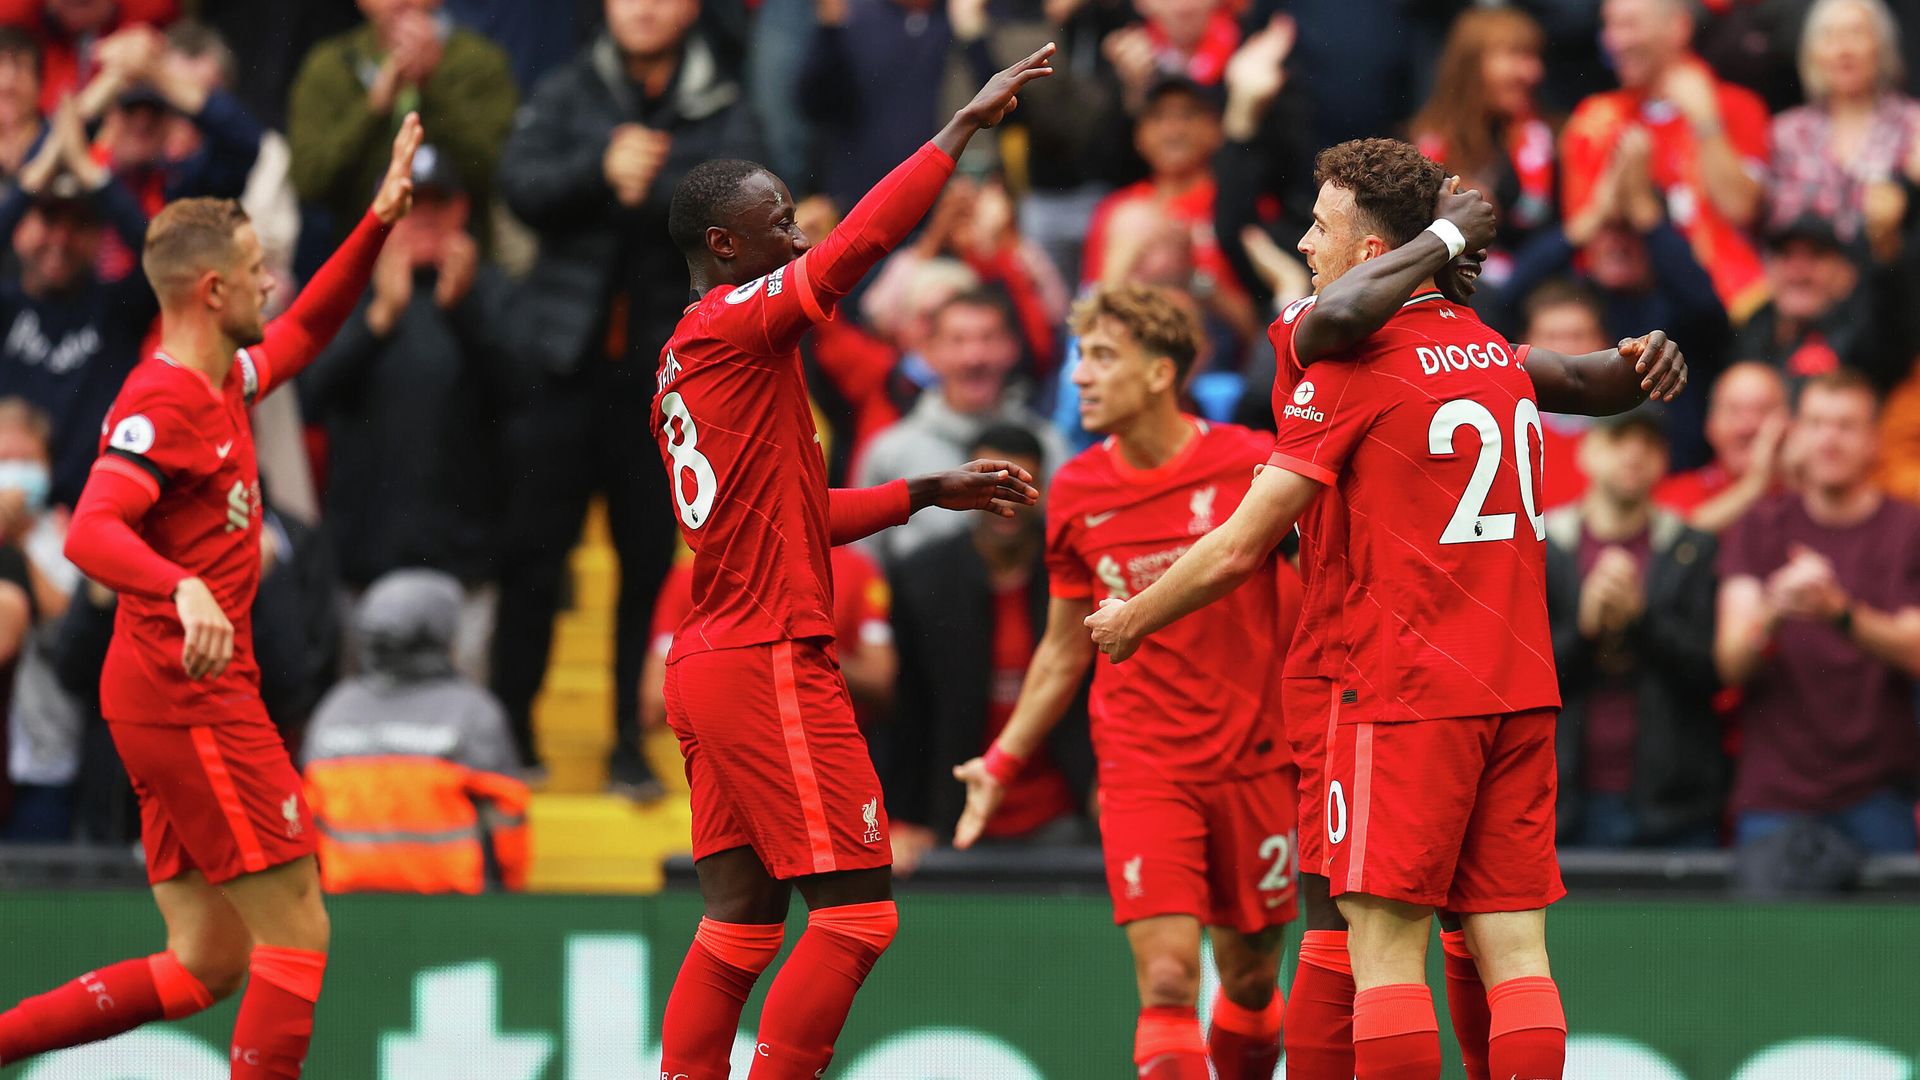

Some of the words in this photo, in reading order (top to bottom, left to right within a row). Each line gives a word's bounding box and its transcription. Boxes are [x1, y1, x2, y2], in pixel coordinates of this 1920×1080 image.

[1416, 341, 1509, 375] DIOGO
[661, 391, 718, 530] 8
[1428, 398, 1546, 545] 20
[1327, 780, 1347, 844] 0
